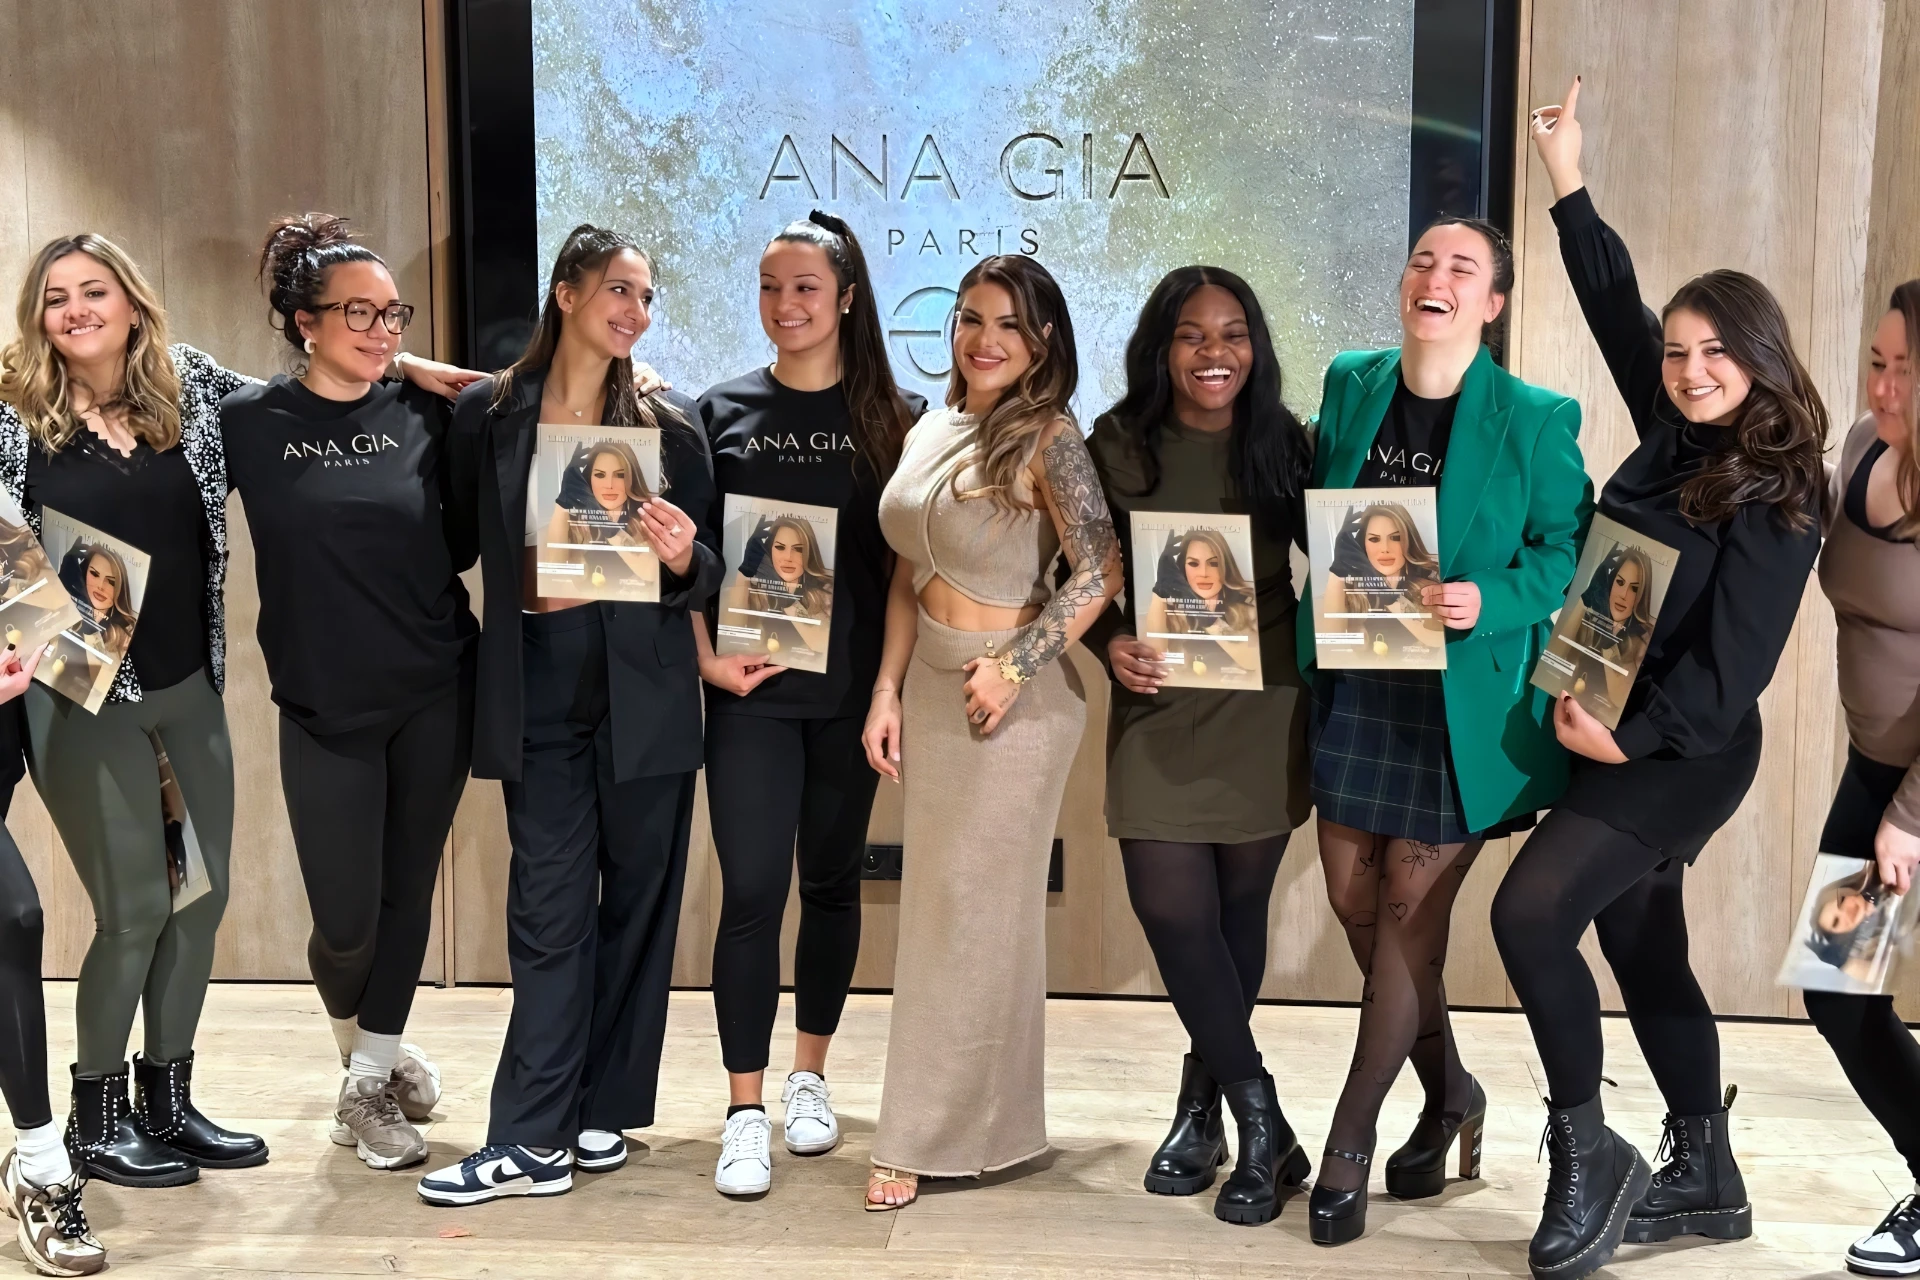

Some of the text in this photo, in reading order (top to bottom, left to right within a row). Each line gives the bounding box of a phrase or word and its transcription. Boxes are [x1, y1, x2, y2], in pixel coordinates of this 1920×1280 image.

[759, 132, 1170, 201] ANA GIA
[888, 229, 1040, 256] PARIS
[284, 433, 399, 460] ANA GIA
[744, 432, 856, 453] ANA GIA
[324, 458, 370, 468] PARIS
[778, 455, 822, 463] PARIS
[1411, 452, 1443, 476] GI
